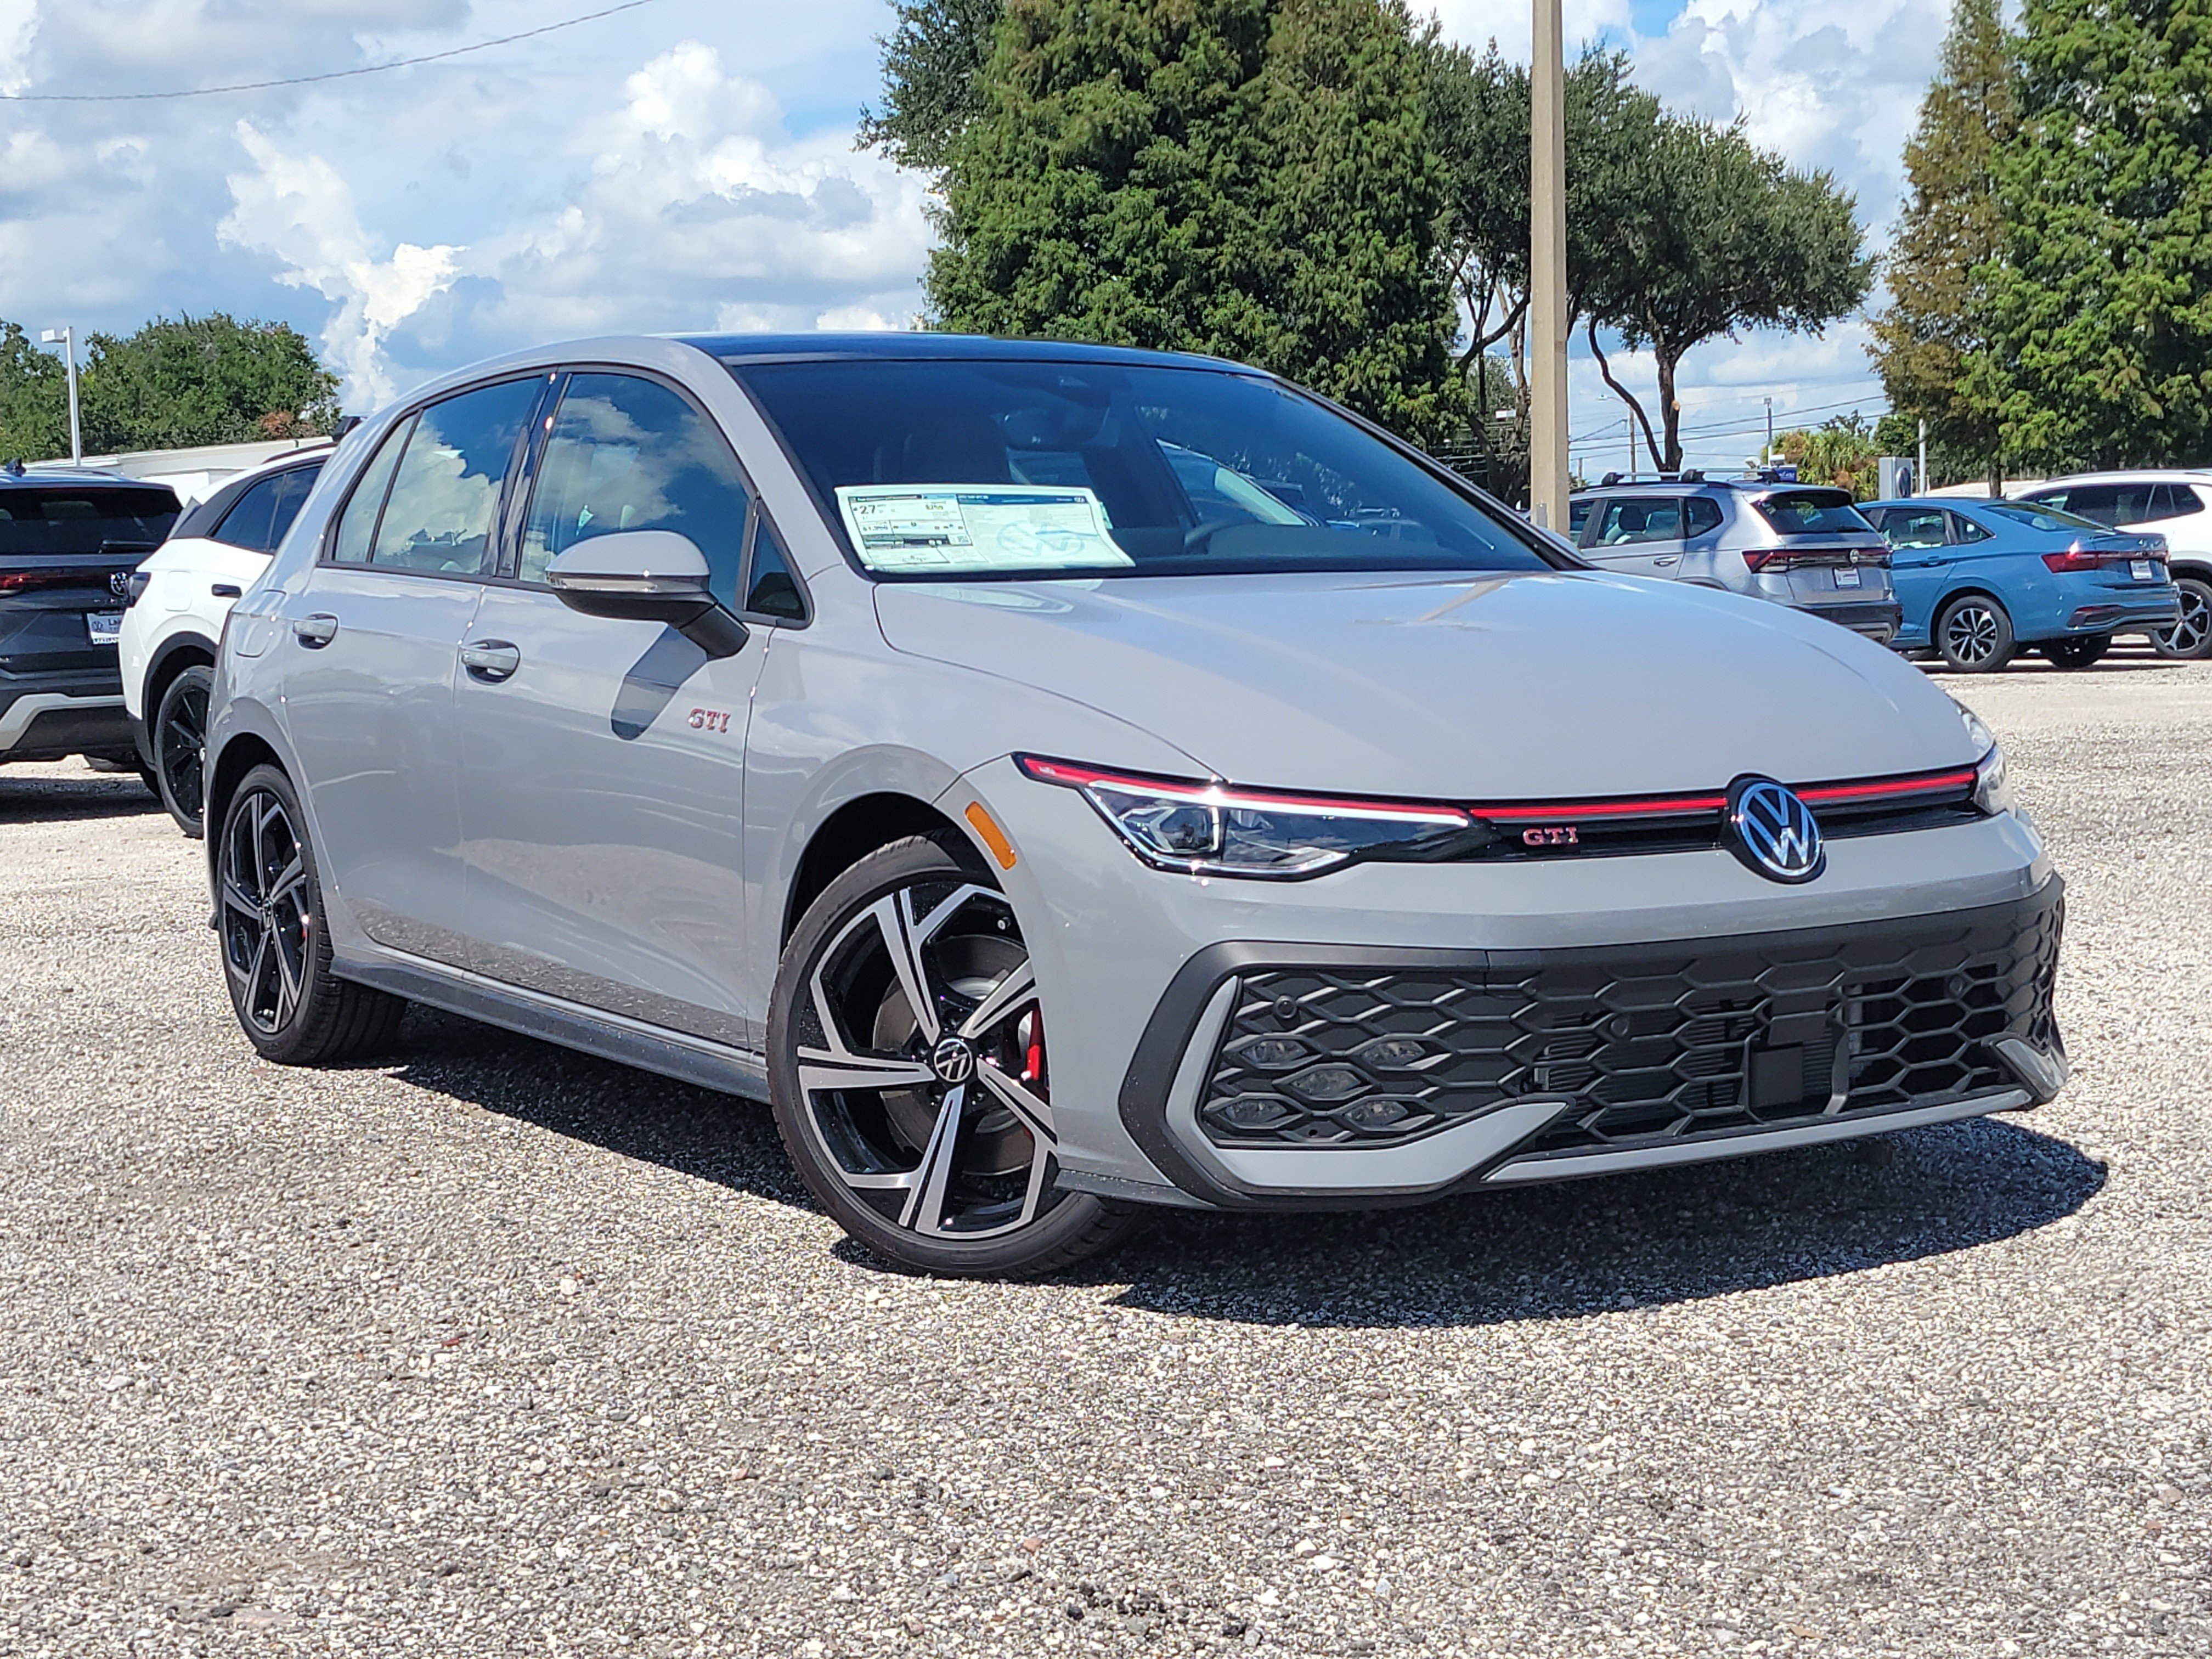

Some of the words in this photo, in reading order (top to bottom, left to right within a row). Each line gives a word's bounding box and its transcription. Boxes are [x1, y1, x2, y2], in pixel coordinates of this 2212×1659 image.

[859, 504, 876, 515] 27
[688, 708, 731, 733] GTI
[1522, 826, 1579, 846] GTI
[1738, 782, 1820, 876] VW
